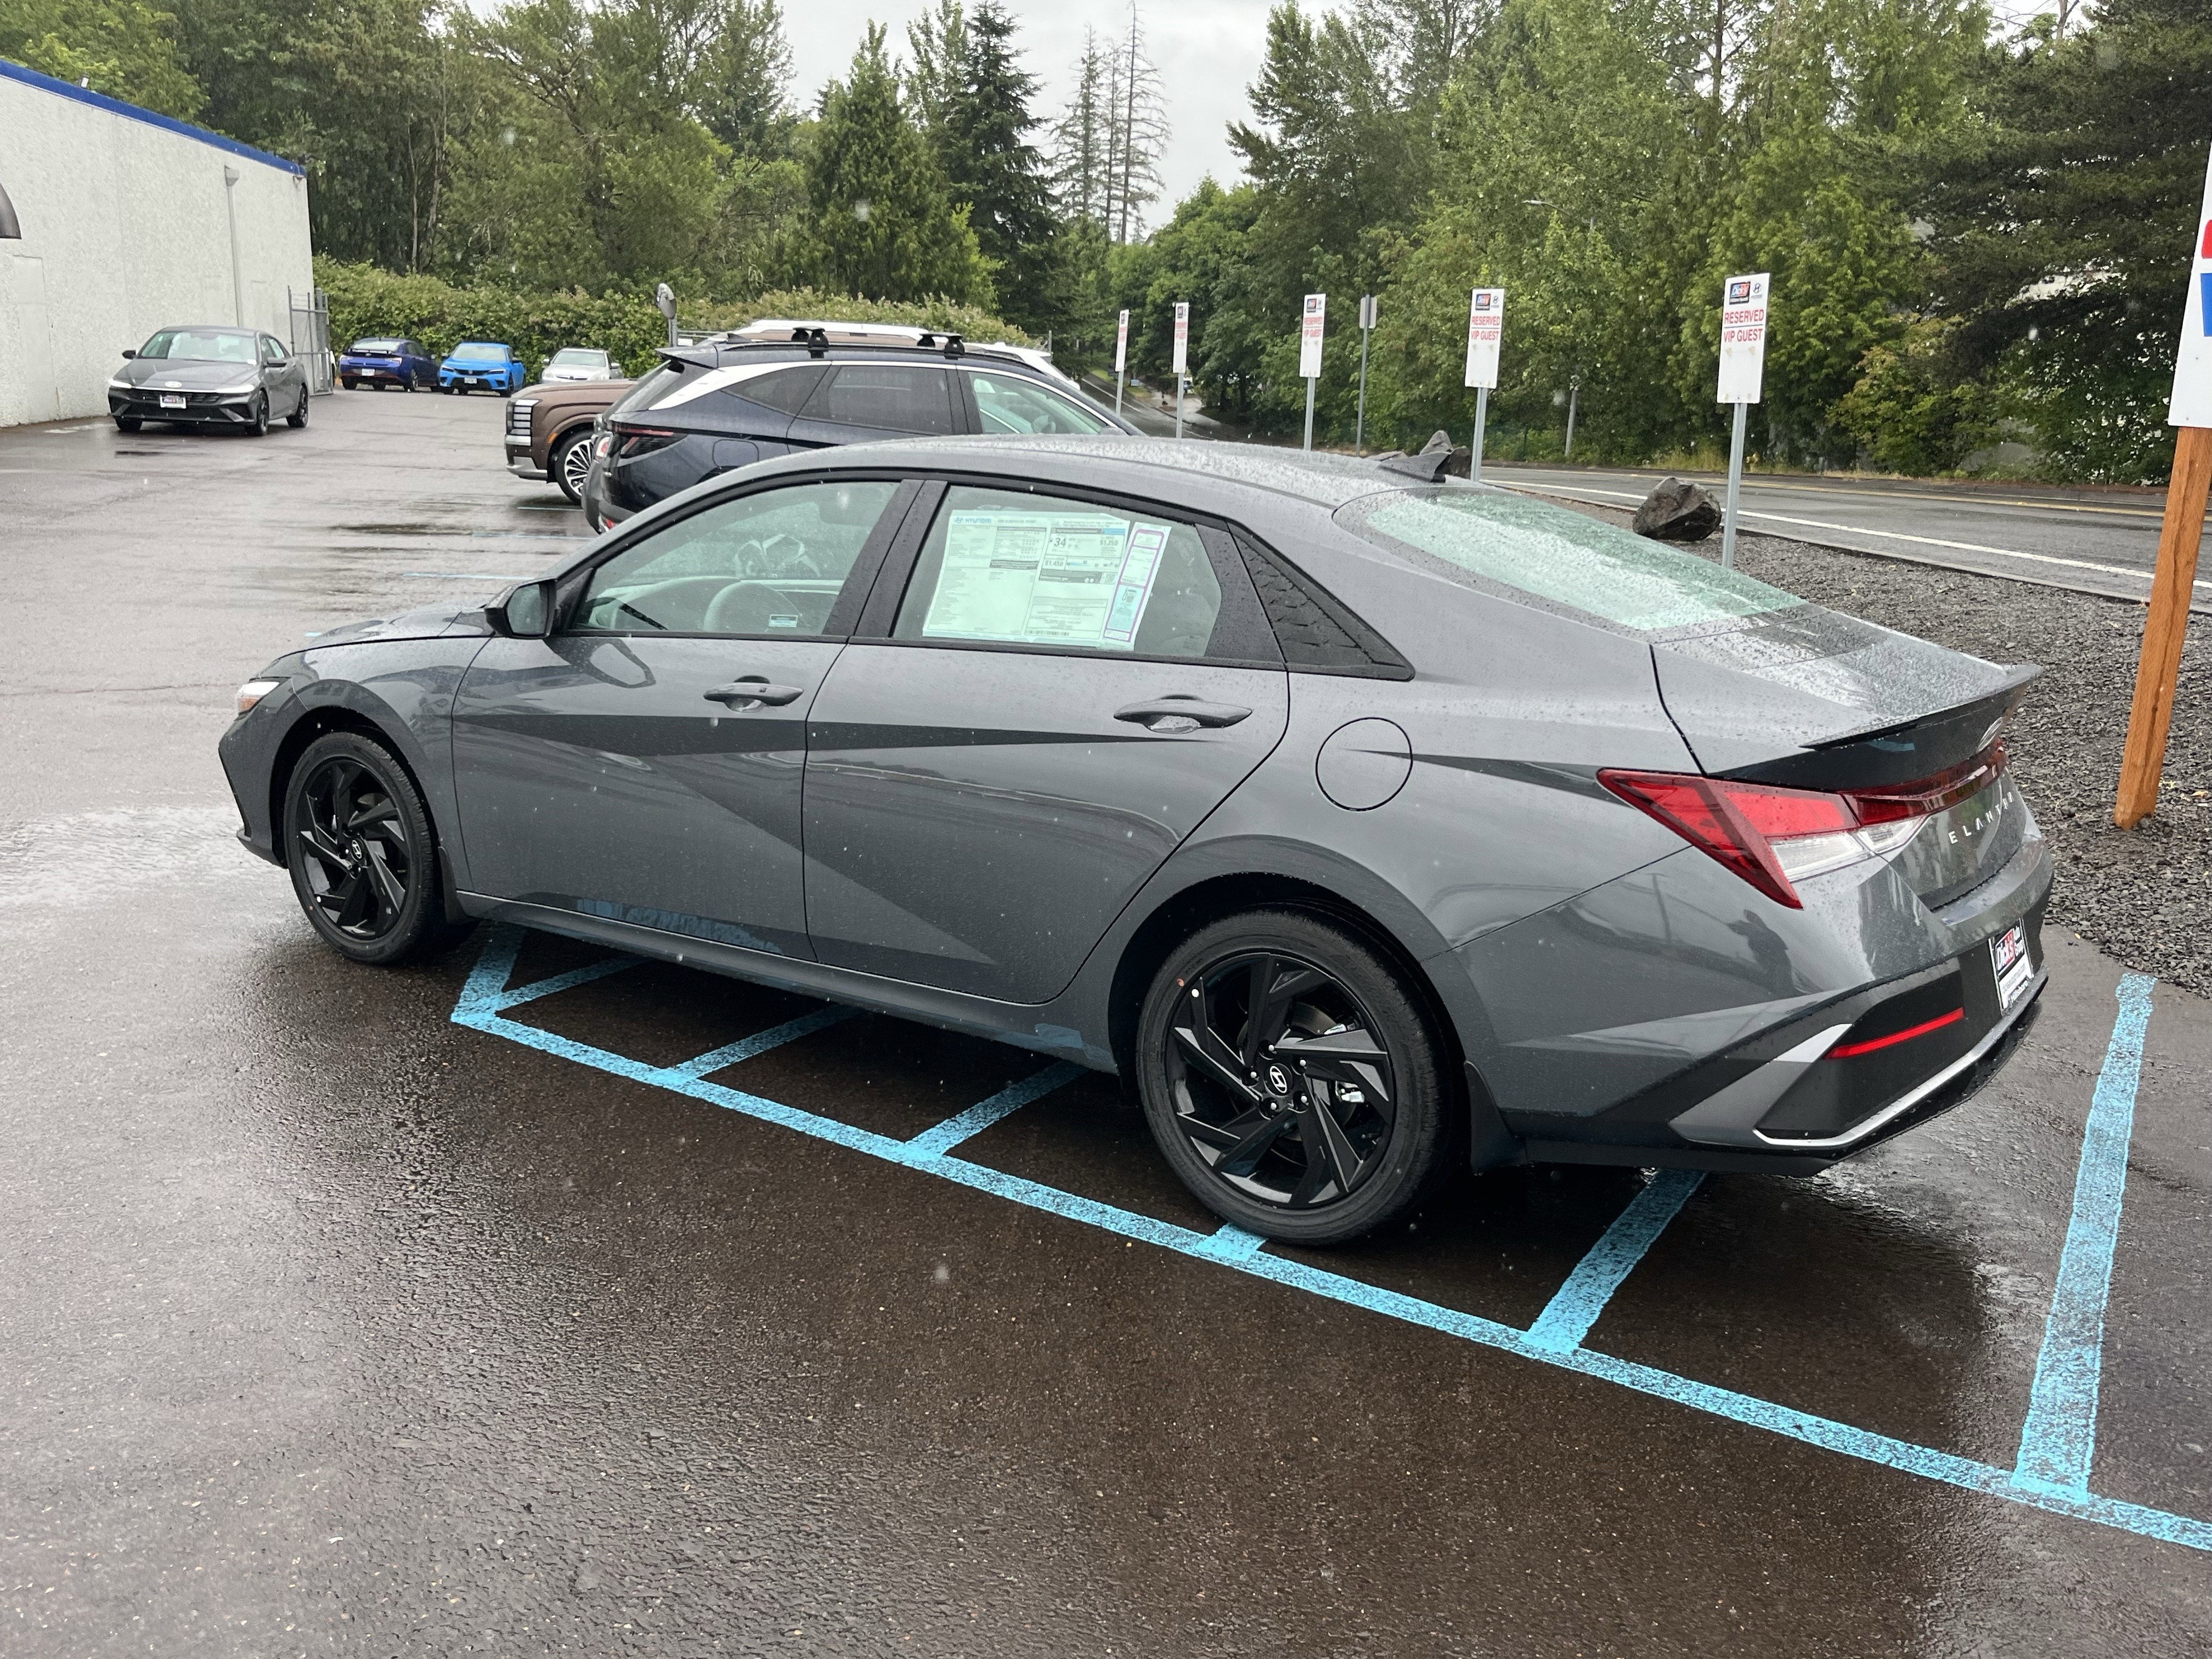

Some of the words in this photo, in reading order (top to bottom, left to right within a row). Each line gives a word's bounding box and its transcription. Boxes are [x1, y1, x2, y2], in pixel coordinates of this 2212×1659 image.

[1471, 316, 1500, 325] RESERVED
[1724, 309, 1764, 324] RESERVED
[1471, 330, 1480, 340] VIP
[1481, 330, 1499, 340] GUEST
[1724, 331, 1735, 343] VIP
[1737, 329, 1763, 342] GUEST
[1053, 537, 1066, 547] 34
[1948, 791, 2015, 844] ELANTRA
